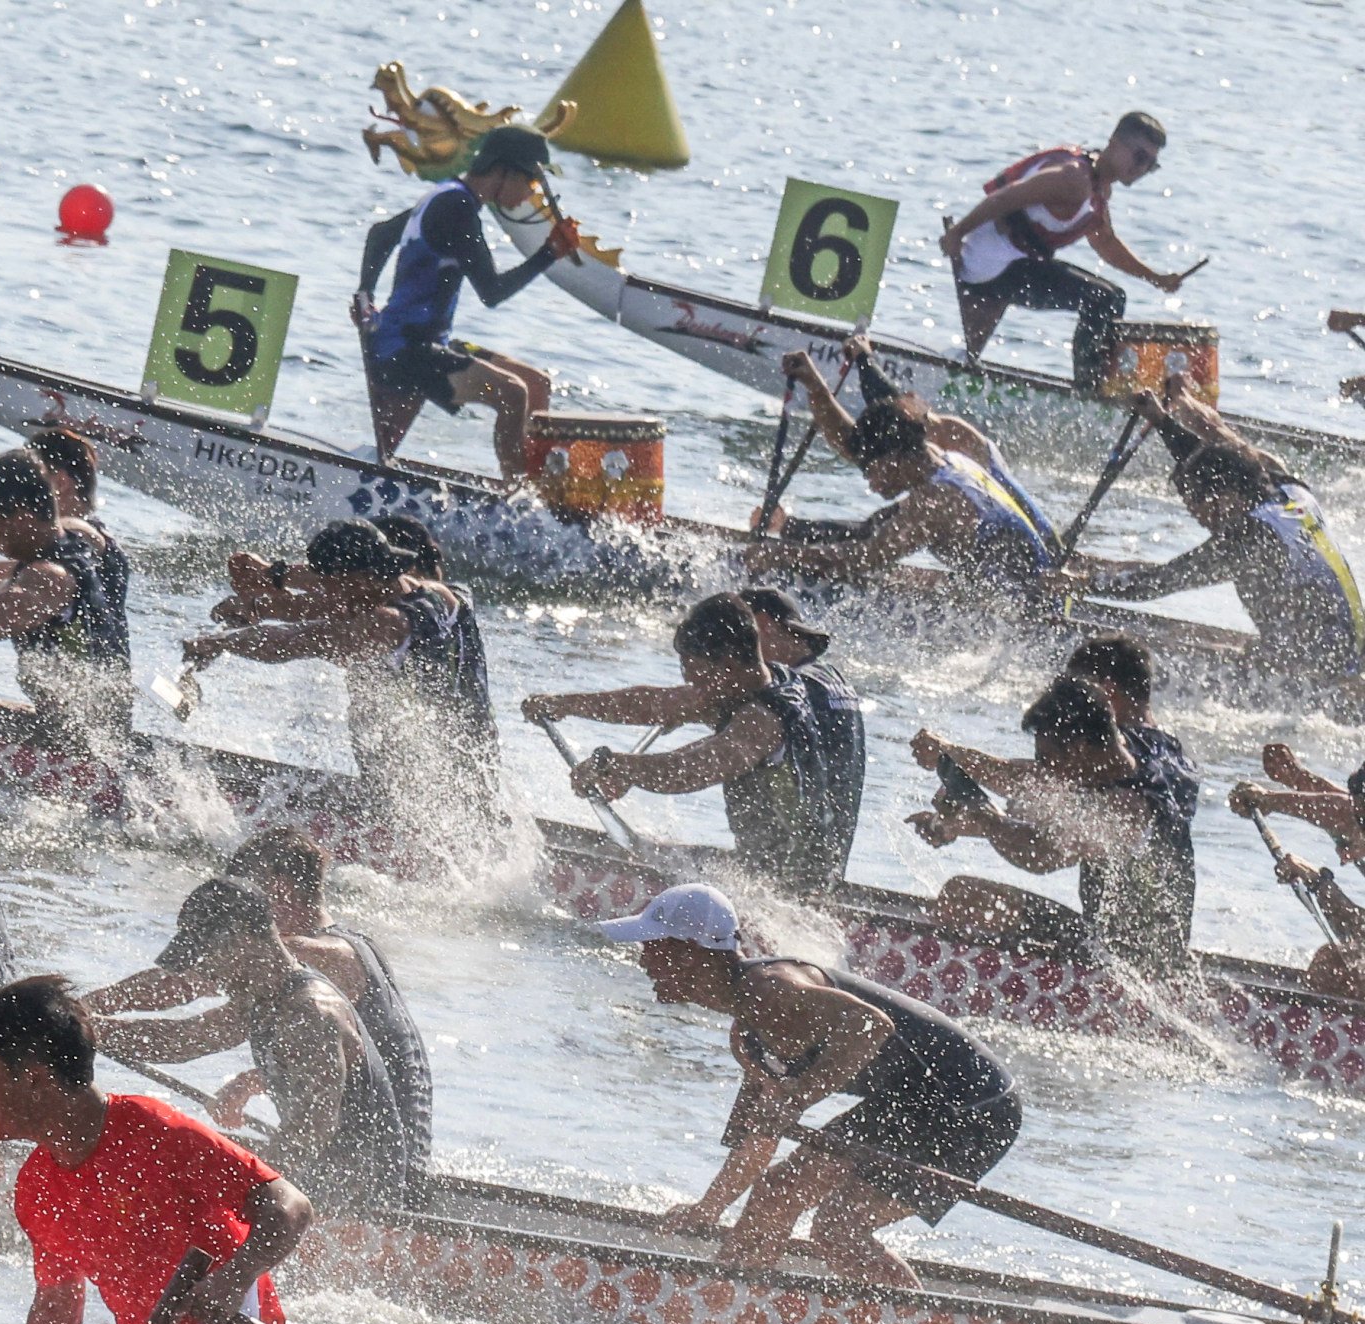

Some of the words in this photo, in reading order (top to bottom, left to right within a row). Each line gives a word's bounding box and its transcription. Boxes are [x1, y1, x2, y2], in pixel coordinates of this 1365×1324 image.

[789, 198, 869, 301] 6
[175, 264, 266, 386] 5
[808, 341, 913, 384] HKBA
[195, 438, 317, 488] HKCDBA
